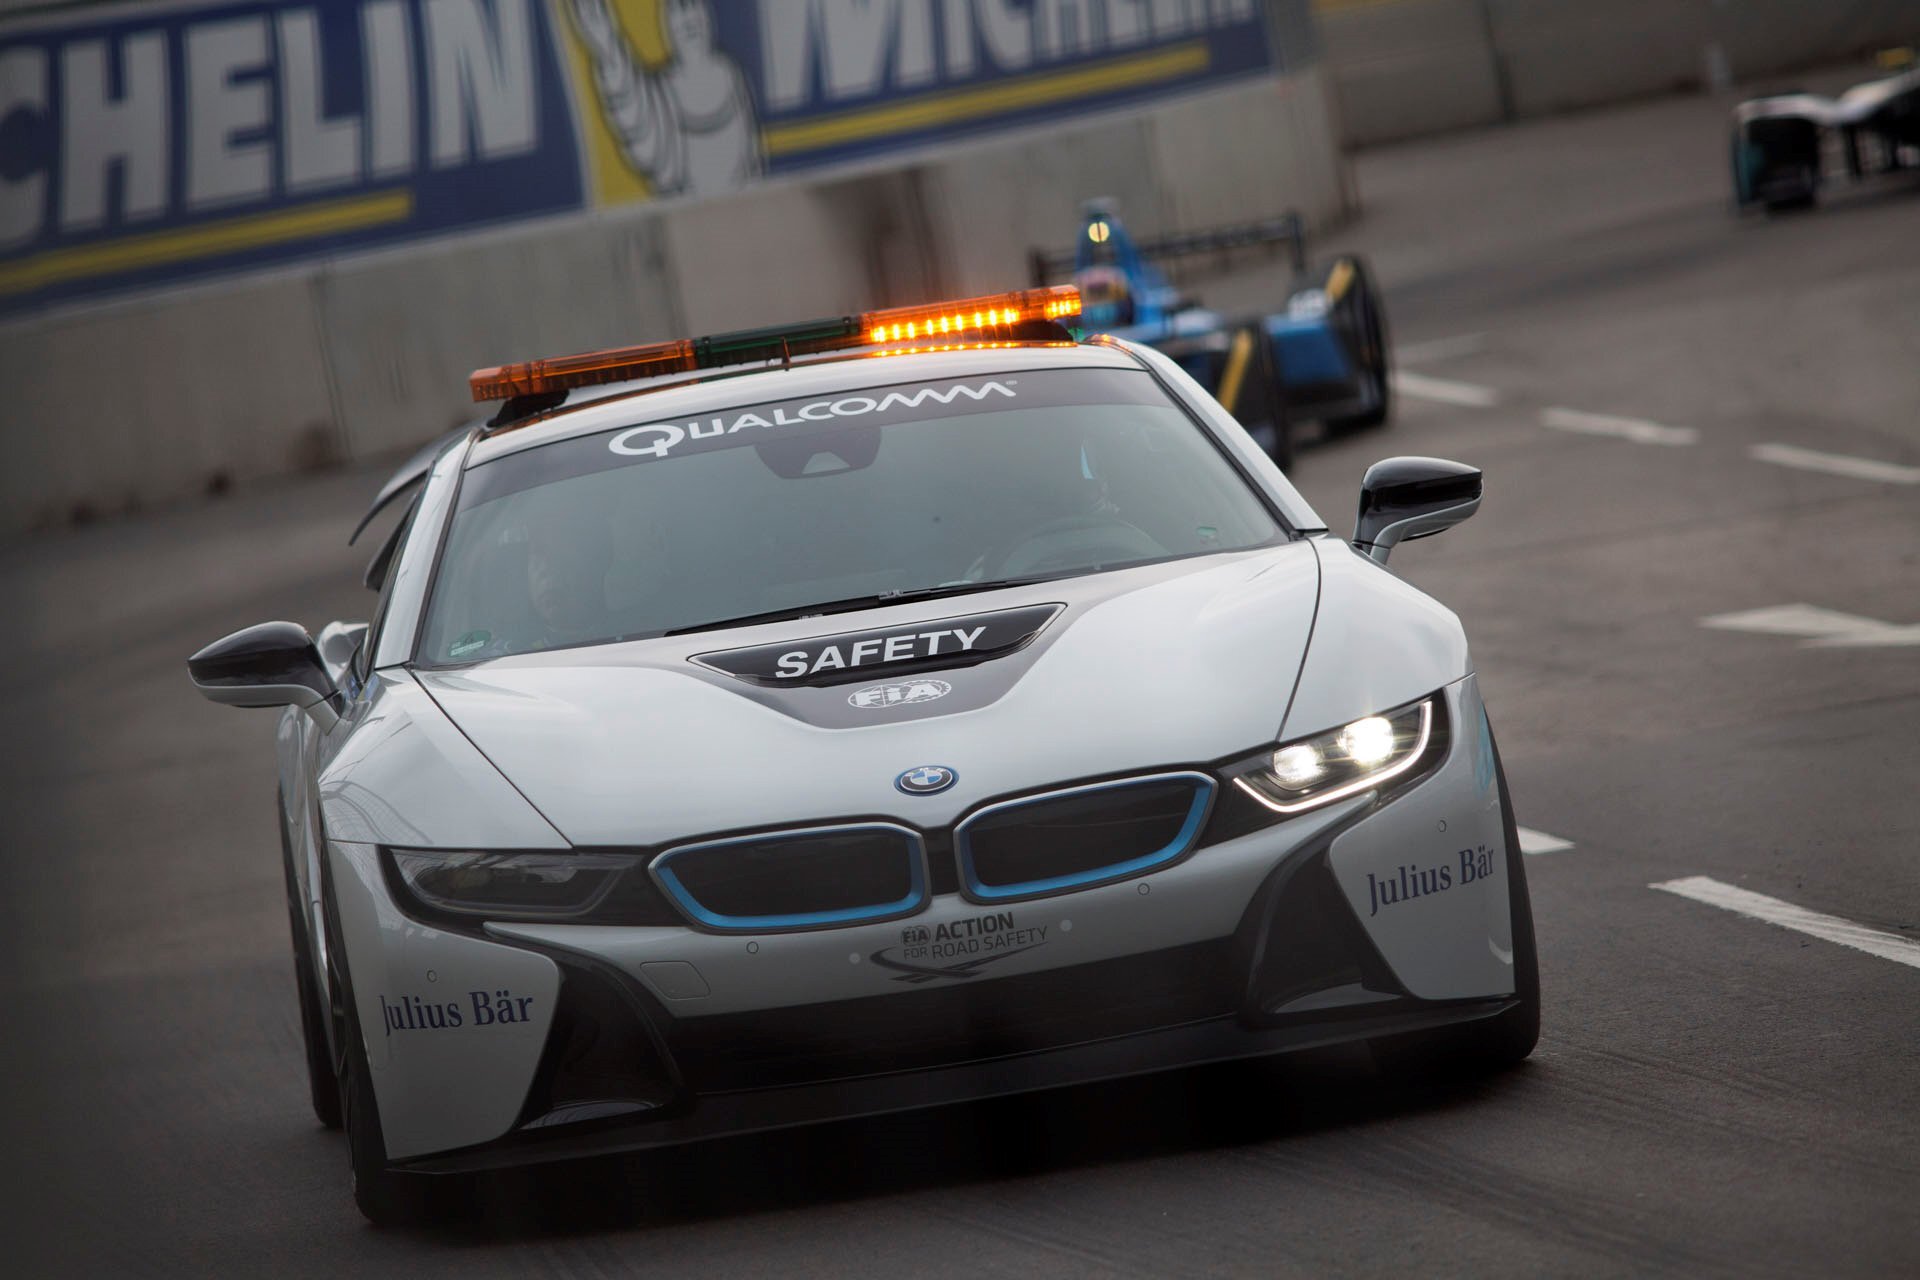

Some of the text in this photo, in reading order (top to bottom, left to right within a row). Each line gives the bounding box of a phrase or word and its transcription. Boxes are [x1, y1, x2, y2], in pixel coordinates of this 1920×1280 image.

[608, 381, 1017, 457] QUALCOMM
[775, 626, 986, 678] SAFETY
[1367, 844, 1495, 917] Julius Bär
[903, 926, 1048, 960] FOR ROAD SAFETY
[935, 911, 1015, 942] ACTION
[380, 990, 533, 1036] Julius Bär
